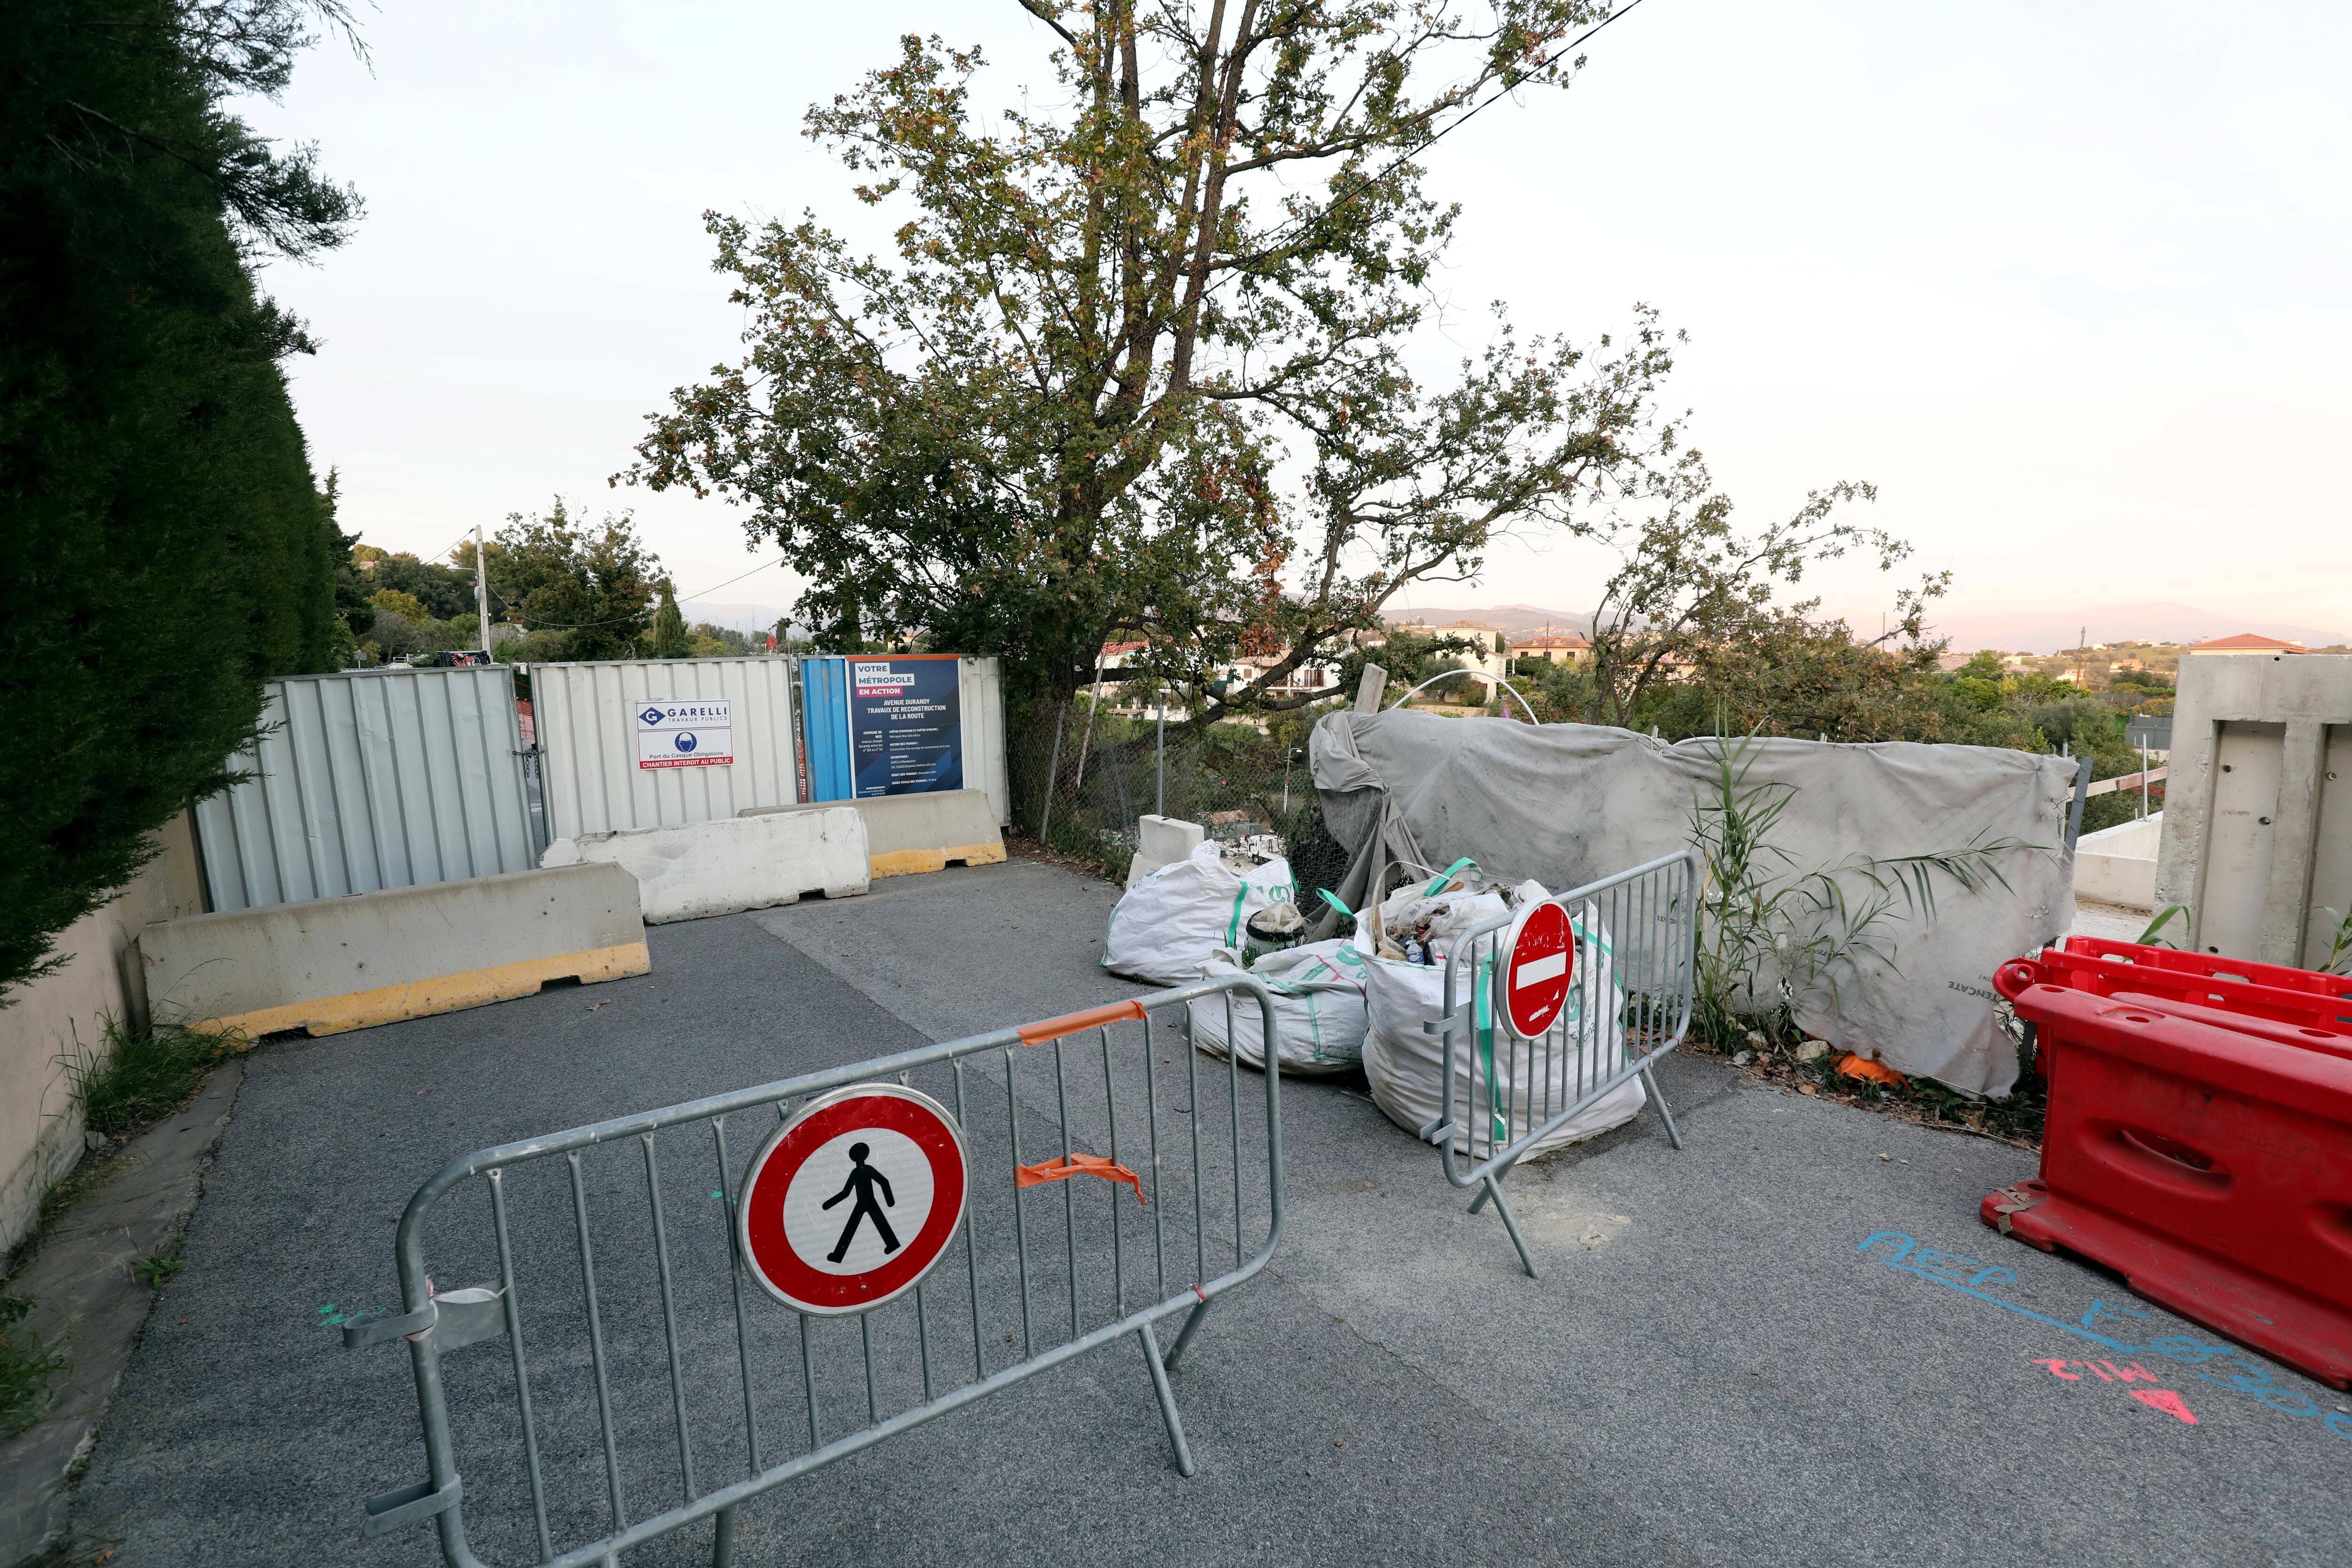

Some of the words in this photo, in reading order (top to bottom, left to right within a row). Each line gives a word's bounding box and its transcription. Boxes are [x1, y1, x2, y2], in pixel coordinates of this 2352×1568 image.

[858, 676, 912, 684] MÉTROPOLE
[667, 707, 727, 716] GARELLI
[1948, 981, 1998, 1002] TENCATE
[1858, 1231, 2019, 1284] AEP
